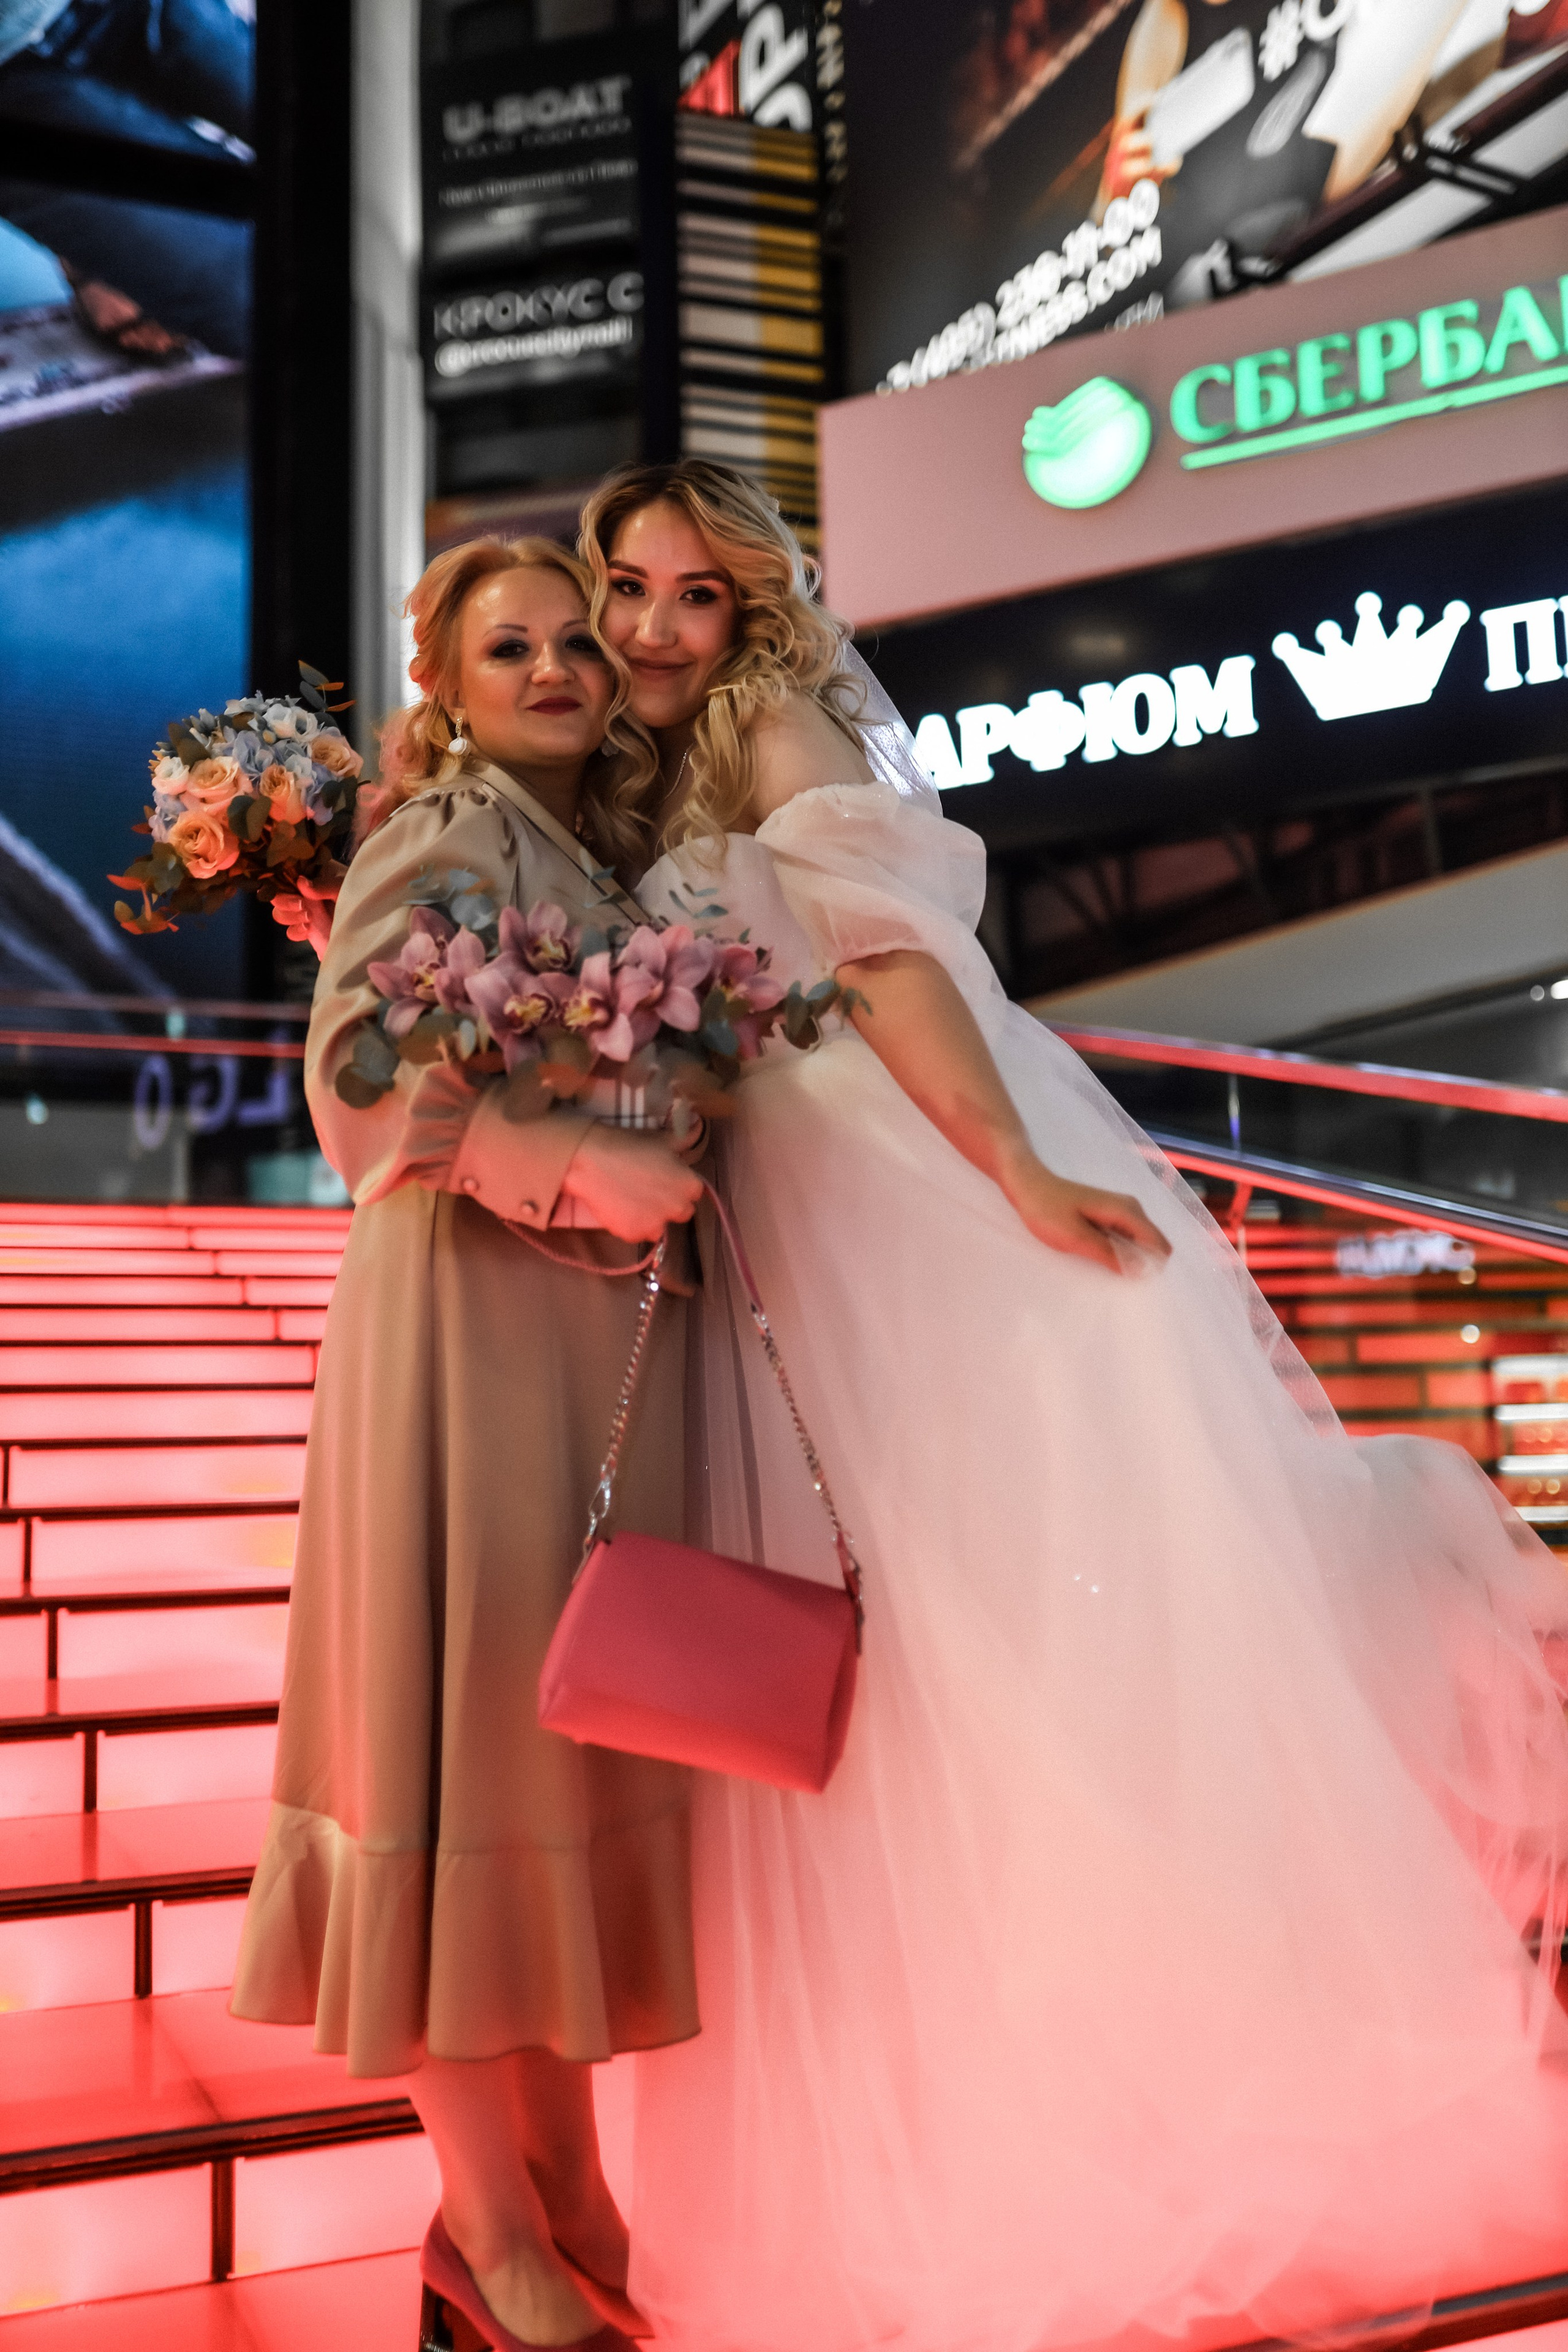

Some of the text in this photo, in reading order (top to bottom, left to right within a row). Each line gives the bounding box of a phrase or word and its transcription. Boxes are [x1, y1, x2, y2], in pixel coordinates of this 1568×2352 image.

[441, 72, 633, 146] U-BOAT
[1169, 274, 1568, 445] СБЕРБА
[914, 654, 1260, 791] АРФЮМ
